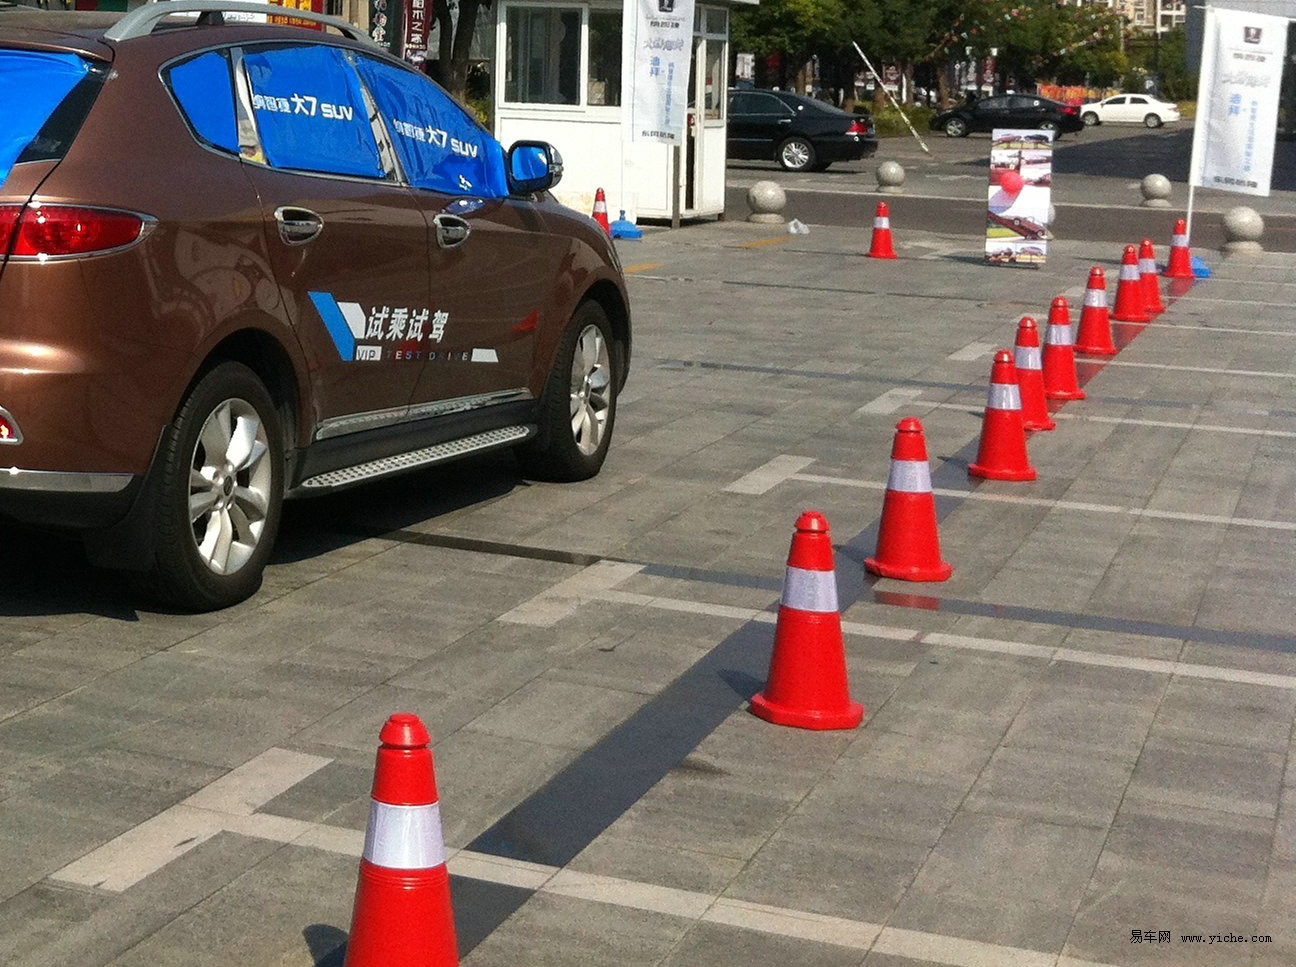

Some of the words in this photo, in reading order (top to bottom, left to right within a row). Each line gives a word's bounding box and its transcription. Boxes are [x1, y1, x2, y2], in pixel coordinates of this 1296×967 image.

[321, 103, 353, 121] SUV
[450, 138, 478, 158] SUV
[365, 306, 450, 343] 试乘试驾
[385, 349, 422, 361] TEST
